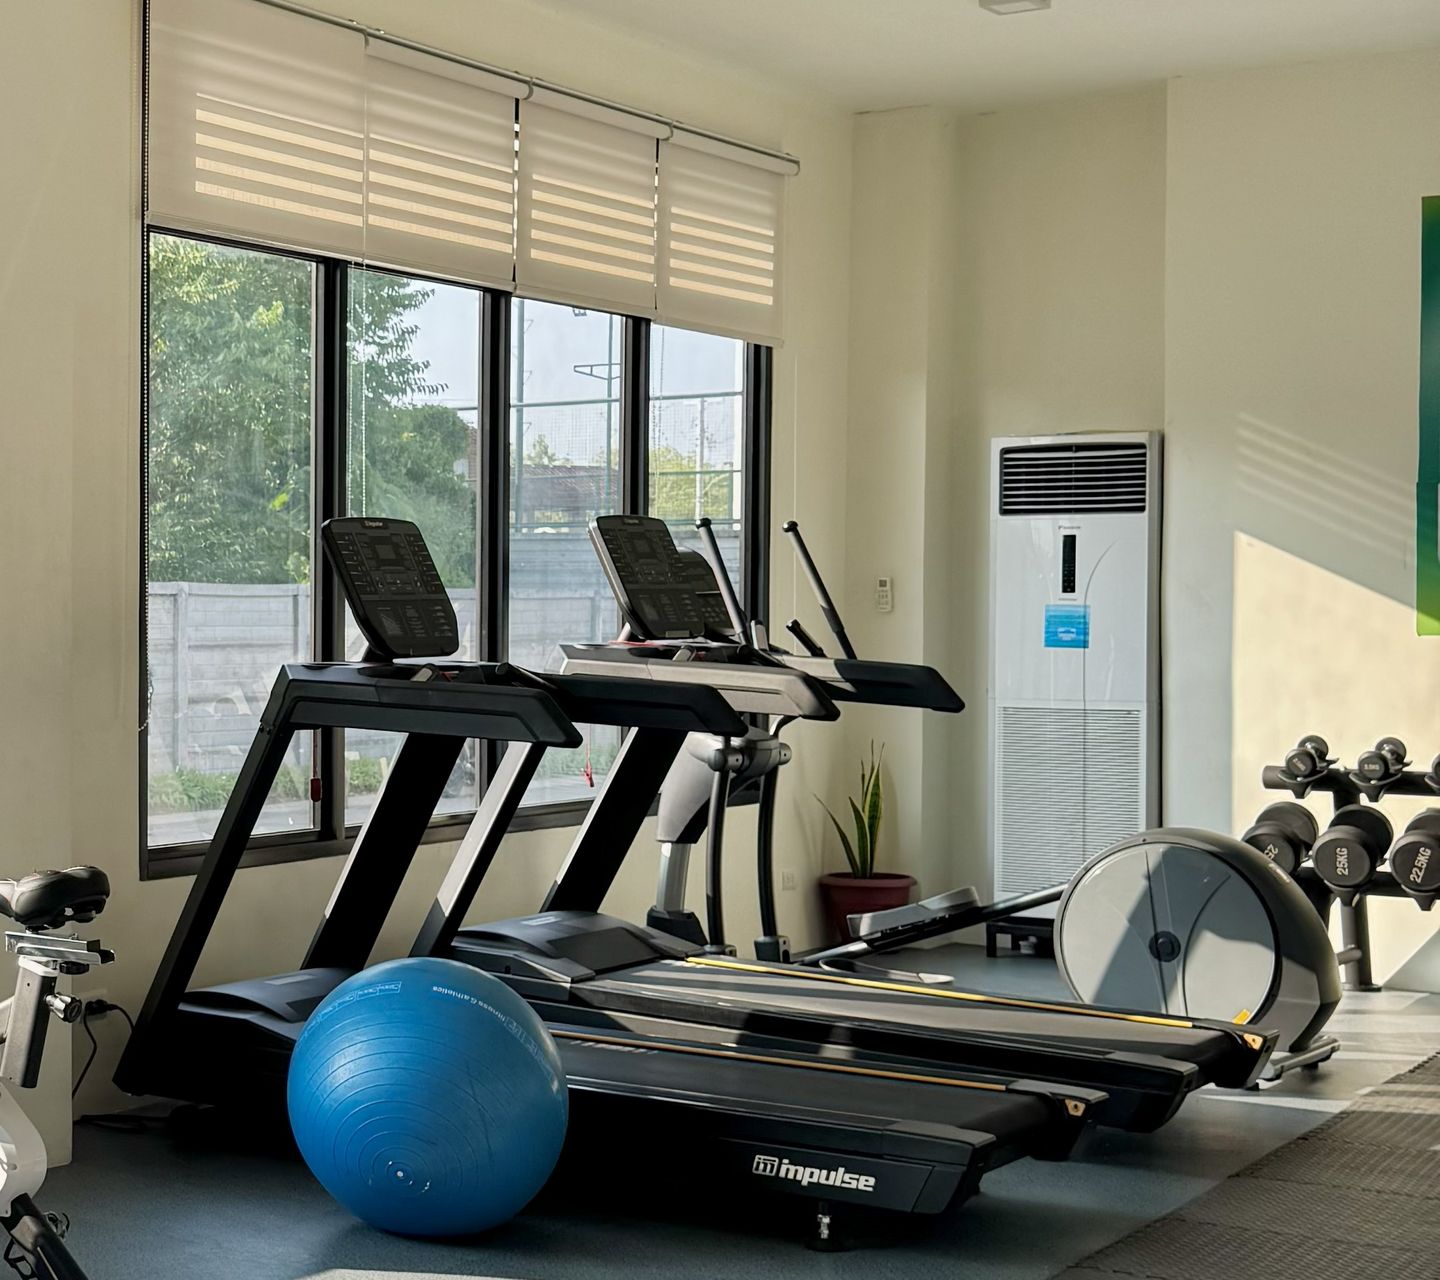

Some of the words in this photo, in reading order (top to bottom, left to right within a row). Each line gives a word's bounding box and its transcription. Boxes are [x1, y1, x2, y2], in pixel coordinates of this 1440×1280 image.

[1336, 847, 1349, 876] 25KG
[1409, 846, 1432, 883] 22.5KG
[432, 985, 470, 1000] athletics
[779, 1158, 876, 1192] impulse
